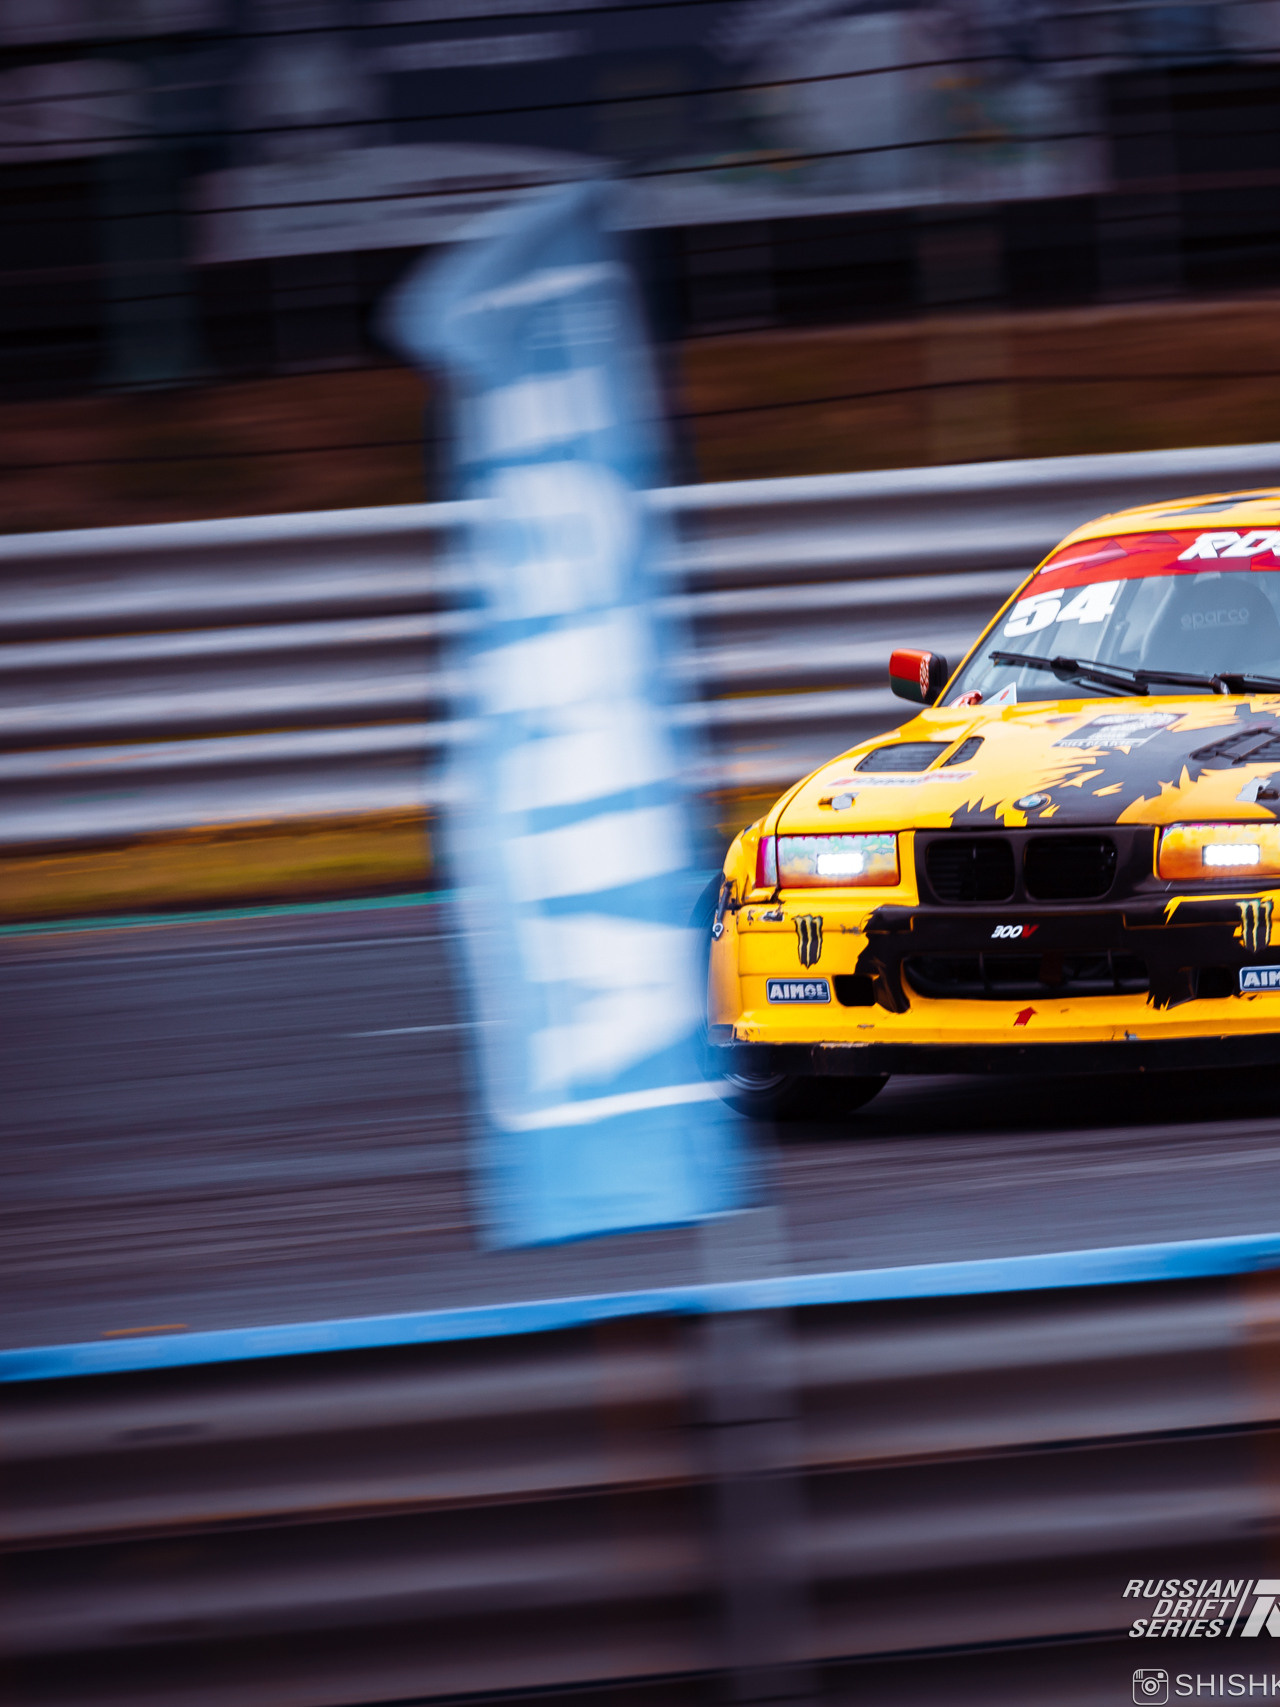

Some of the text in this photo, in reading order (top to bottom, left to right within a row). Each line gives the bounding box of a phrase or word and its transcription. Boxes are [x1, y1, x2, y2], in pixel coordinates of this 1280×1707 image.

[1003, 580, 1120, 637] 54
[991, 924, 1039, 939] 300V
[770, 983, 827, 999] AIMOL
